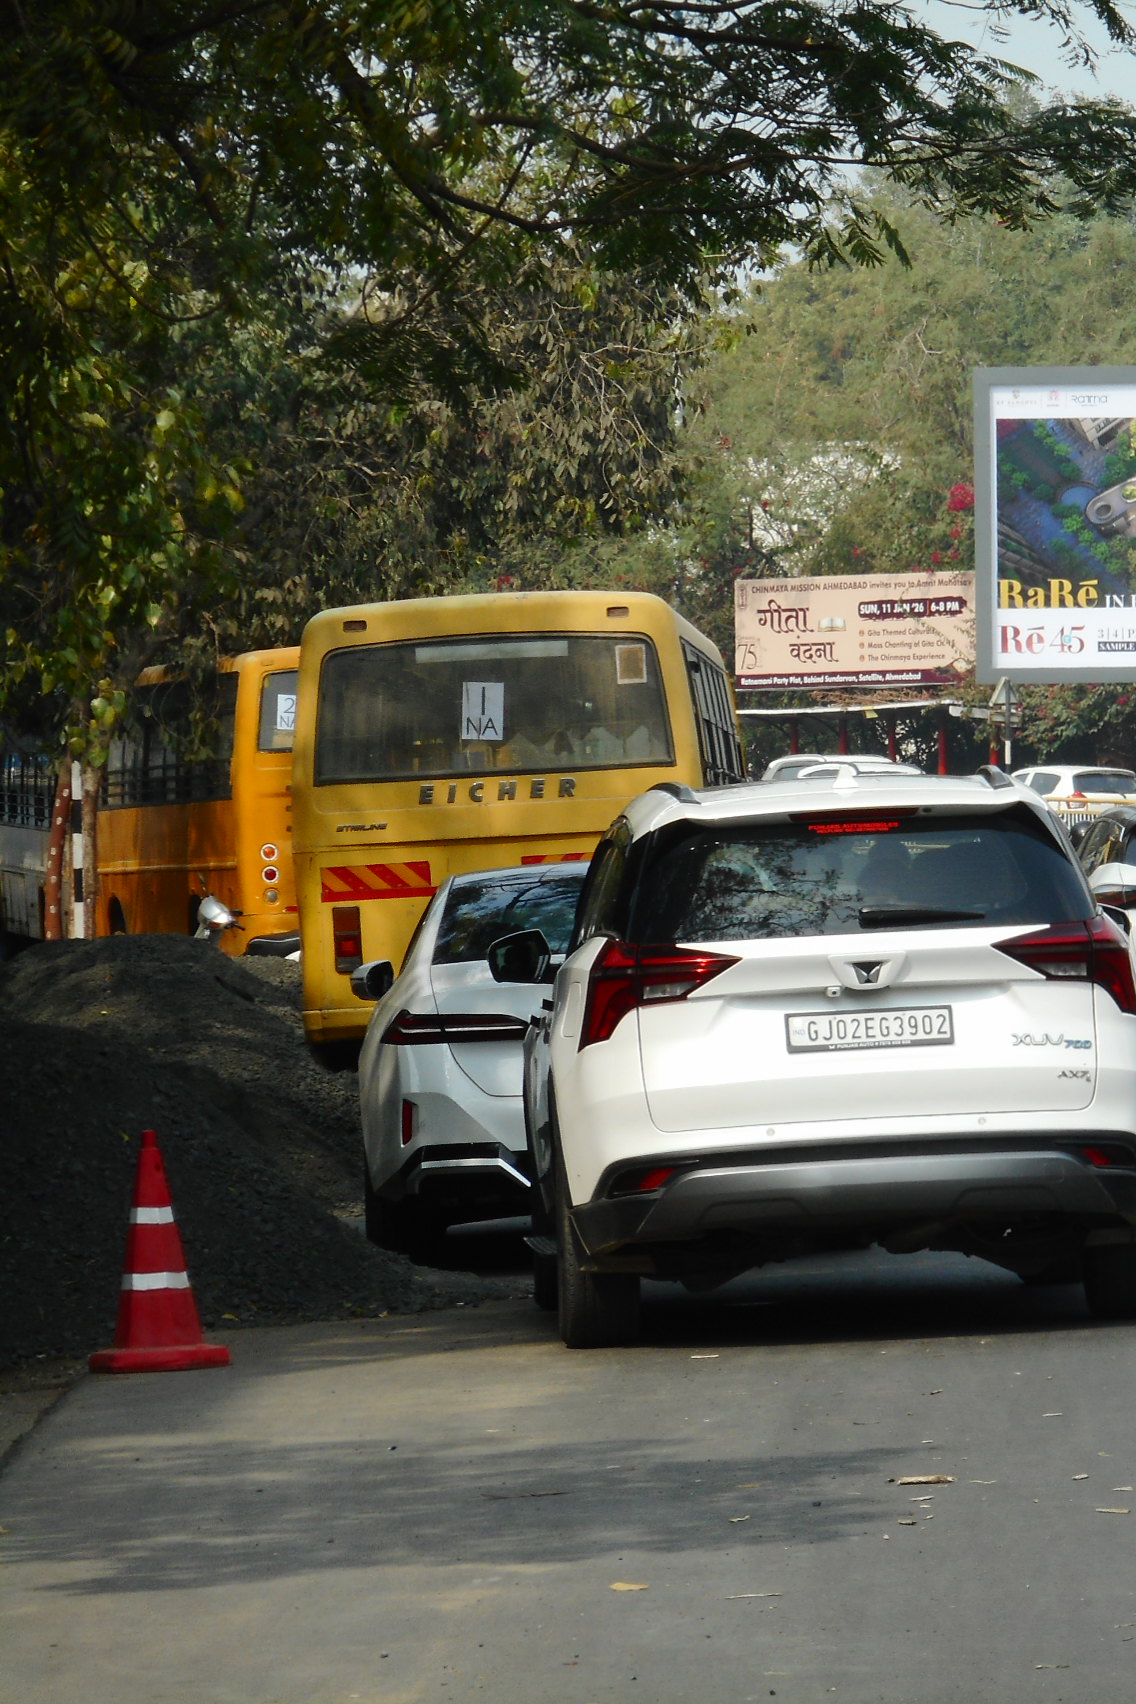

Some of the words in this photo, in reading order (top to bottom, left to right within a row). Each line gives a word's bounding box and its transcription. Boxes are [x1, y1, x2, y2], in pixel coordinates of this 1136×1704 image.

[752, 585, 789, 594] CHINMAYA
[790, 583, 820, 592] MISSION
[823, 581, 867, 591] AHMEDABAD
[869, 581, 892, 589] invites
[893, 581, 906, 590] you
[860, 604, 880, 615] SUN,
[882, 603, 891, 613] 11
[931, 602, 945, 611] 6-8
[946, 601, 959, 611] PM
[1105, 594, 1125, 608] IN
[757, 599, 814, 633] गीता
[1049, 625, 1086, 654] 45
[1099, 642, 1136, 651] SAMPLE
[737, 643, 758, 670] 75
[789, 635, 839, 663] वंदना
[880, 654, 911, 662] Chinmaya
[774, 676, 788, 686] Party
[804, 675, 825, 684] Behind
[885, 672, 921, 681] Ahmedabad
[284, 697, 295, 713] 2
[466, 717, 498, 736] NA
[419, 777, 577, 805] EICHER
[807, 1013, 948, 1042] GJ02EG3902
